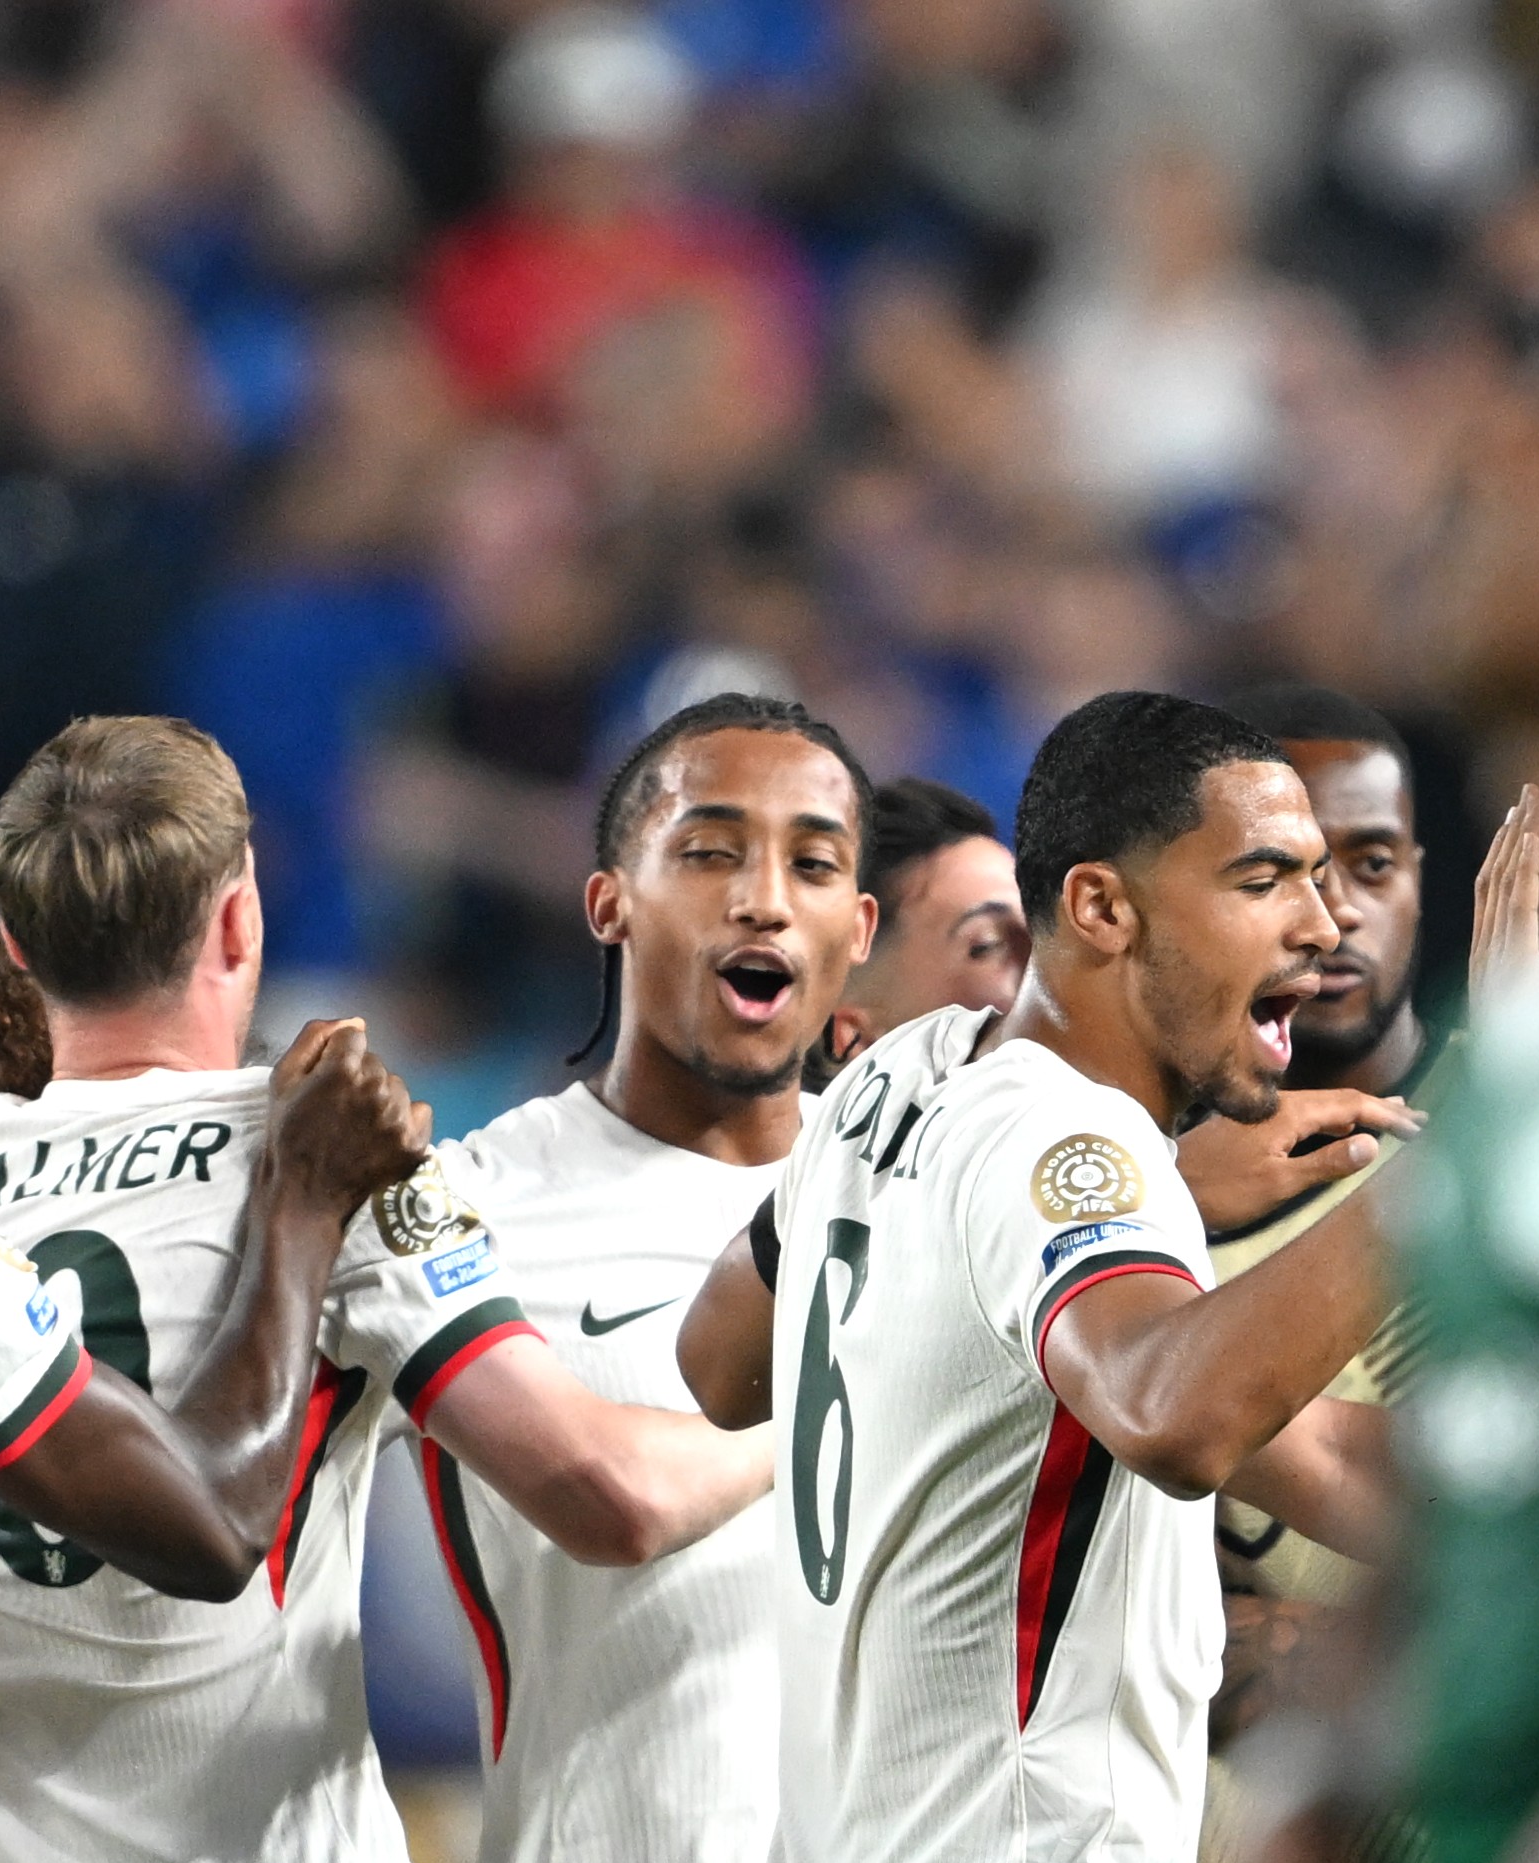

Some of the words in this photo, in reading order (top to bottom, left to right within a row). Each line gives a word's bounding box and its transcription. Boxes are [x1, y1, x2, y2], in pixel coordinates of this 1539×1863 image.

[1041, 1141, 1087, 1179] WORLD
[1091, 1141, 1123, 1160] CUP
[1040, 1182, 1065, 1211] CLUB
[1070, 1198, 1116, 1217] FIFA
[791, 1217, 872, 1607] 6
